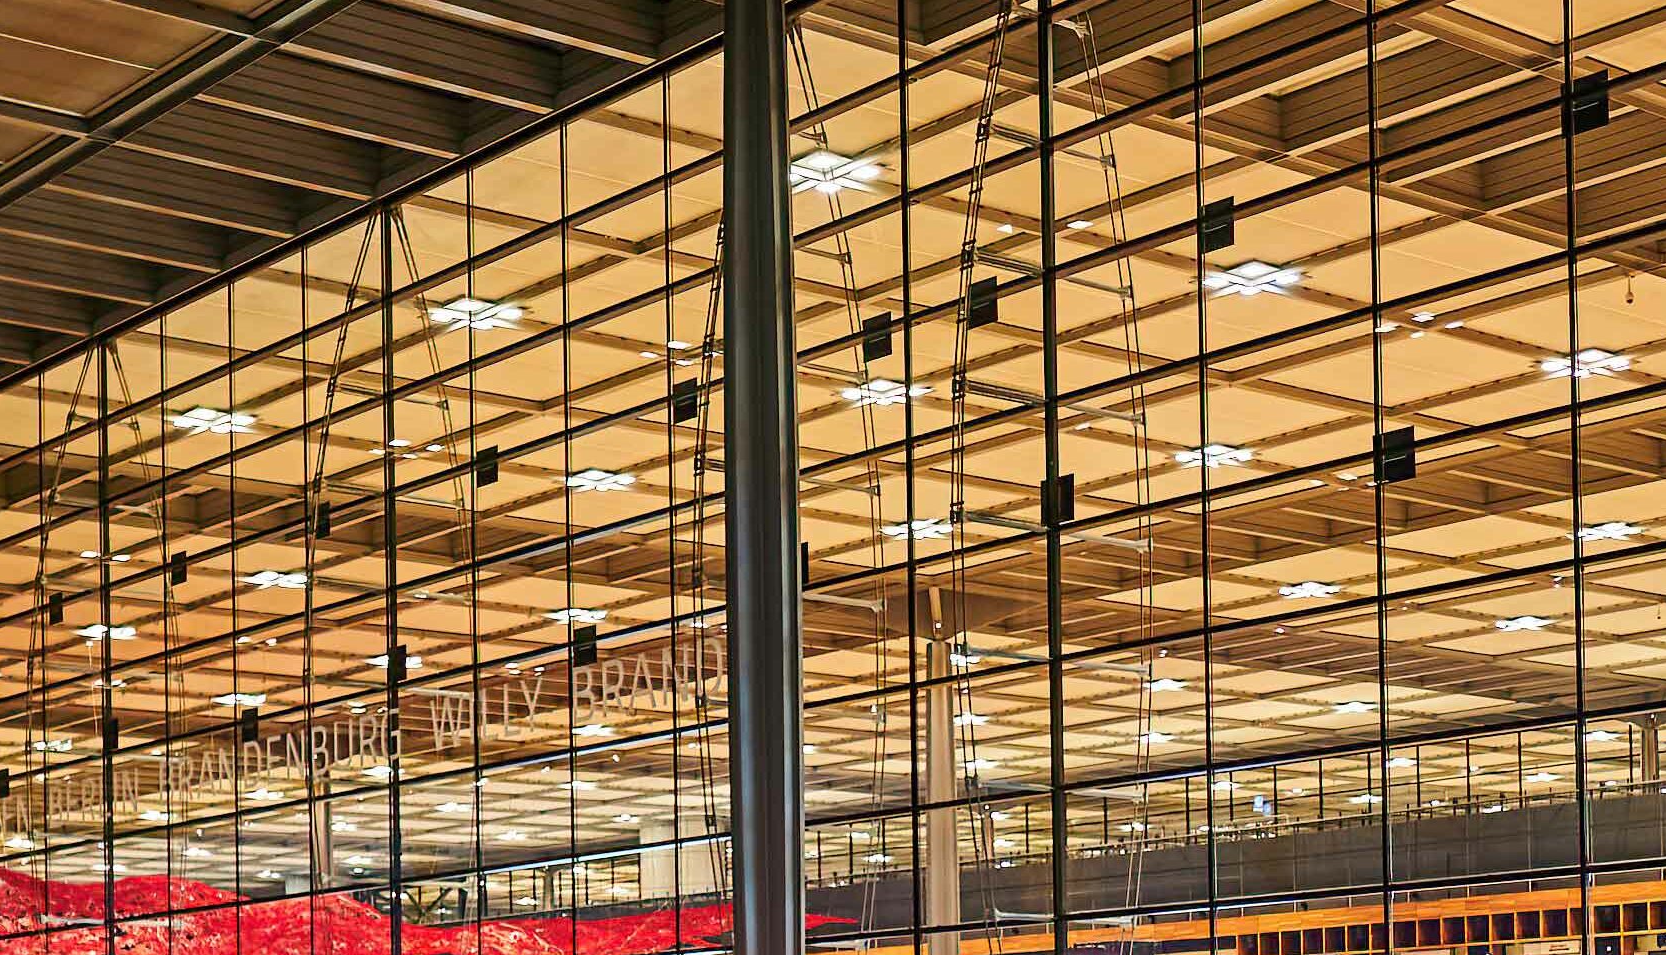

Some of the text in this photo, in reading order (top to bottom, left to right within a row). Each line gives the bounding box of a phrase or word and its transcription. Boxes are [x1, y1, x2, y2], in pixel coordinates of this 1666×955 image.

[159, 708, 401, 800] BRANDENBURG
[430, 675, 543, 751] WILLY
[572, 637, 724, 722] BRAND
